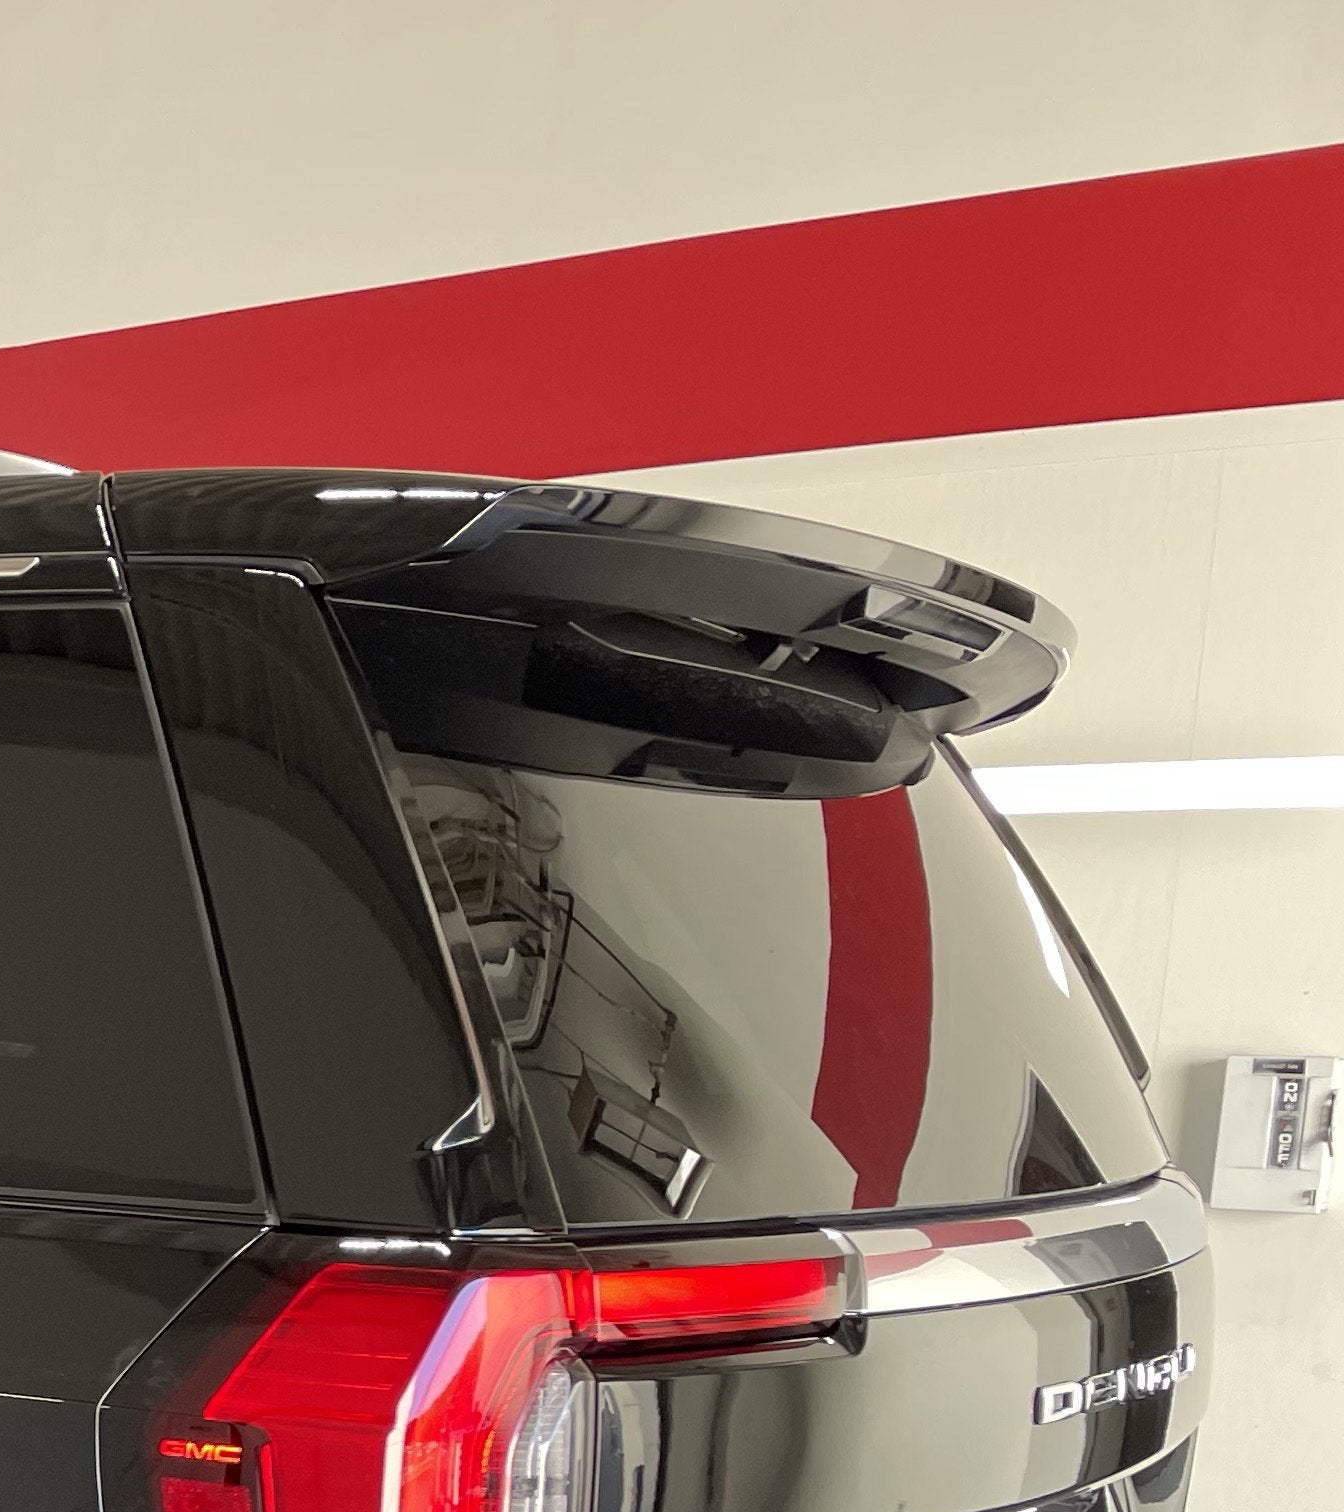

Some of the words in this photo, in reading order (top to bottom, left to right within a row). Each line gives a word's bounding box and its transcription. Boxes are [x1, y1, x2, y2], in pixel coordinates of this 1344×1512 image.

[1283, 1082, 1299, 1102] ON
[1277, 1133, 1293, 1163] OFF
[159, 1439, 242, 1463] GMC
